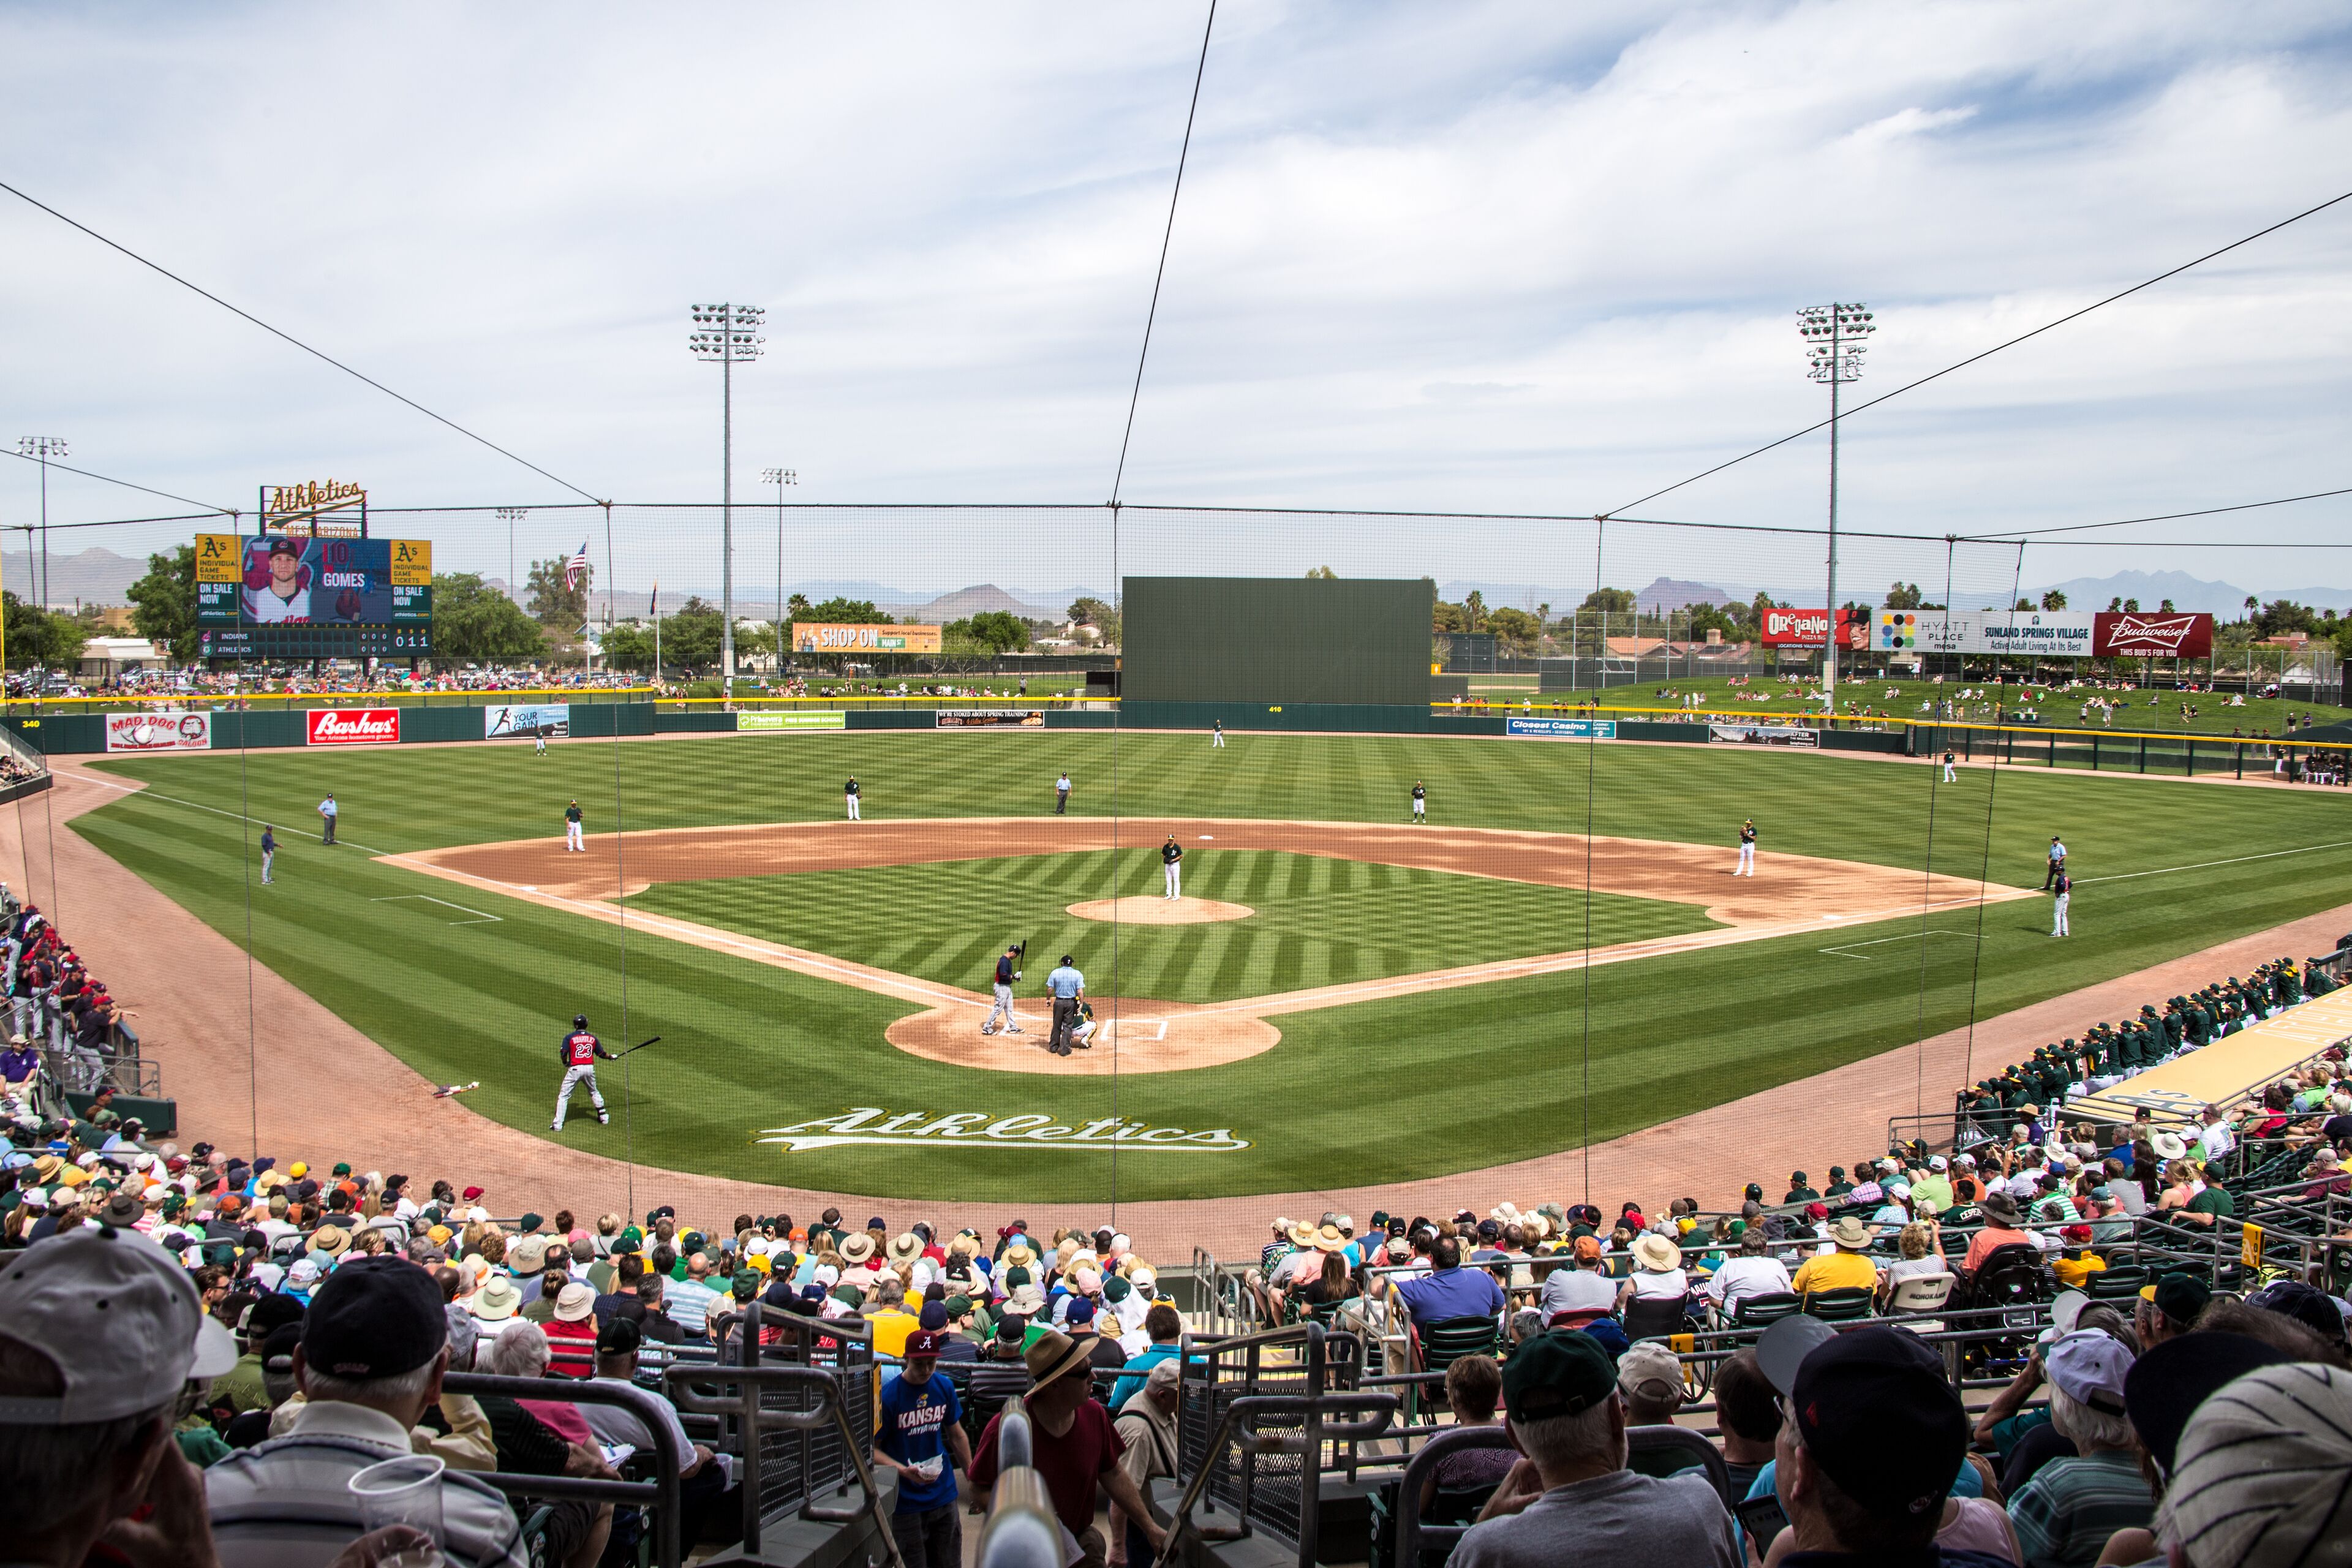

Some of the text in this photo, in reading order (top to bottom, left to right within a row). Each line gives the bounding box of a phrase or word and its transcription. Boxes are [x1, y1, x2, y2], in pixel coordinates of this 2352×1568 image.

[265, 478, 361, 517] Athletics
[287, 525, 359, 538] MESA ARIZONA
[323, 573, 365, 587] GOMES
[200, 584, 233, 594] ON SALE
[393, 586, 423, 596] ON SALE
[200, 594, 219, 604] NOW
[393, 596, 411, 606] NOW
[1921, 622, 1969, 631] HYATT
[1985, 627, 2088, 639] SUNLAND SPRINGS VILLAGE
[2109, 622, 2190, 638] Budweiser
[396, 636, 428, 647] 0 1 1
[821, 628, 878, 647] SHOP ON
[882, 639, 896, 647] MAIN
[1991, 641, 2009, 650] Active
[2010, 640, 2027, 650] Adult
[2029, 641, 2048, 653] Living
[2049, 642, 2056, 651] At
[2067, 642, 2081, 651] Best
[314, 712, 396, 735] Bashas'
[514, 712, 538, 722] YOUR
[111, 716, 176, 732] MAD DOG
[514, 720, 538, 731] GAIN
[177, 739, 208, 747] SALOON
[575, 1043, 593, 1058] 23
[750, 1107, 1254, 1152] Athletics
[919, 1336, 932, 1349] A
[898, 1404, 947, 1428] KANSAS
[908, 1422, 941, 1436] JAYHAWKS
